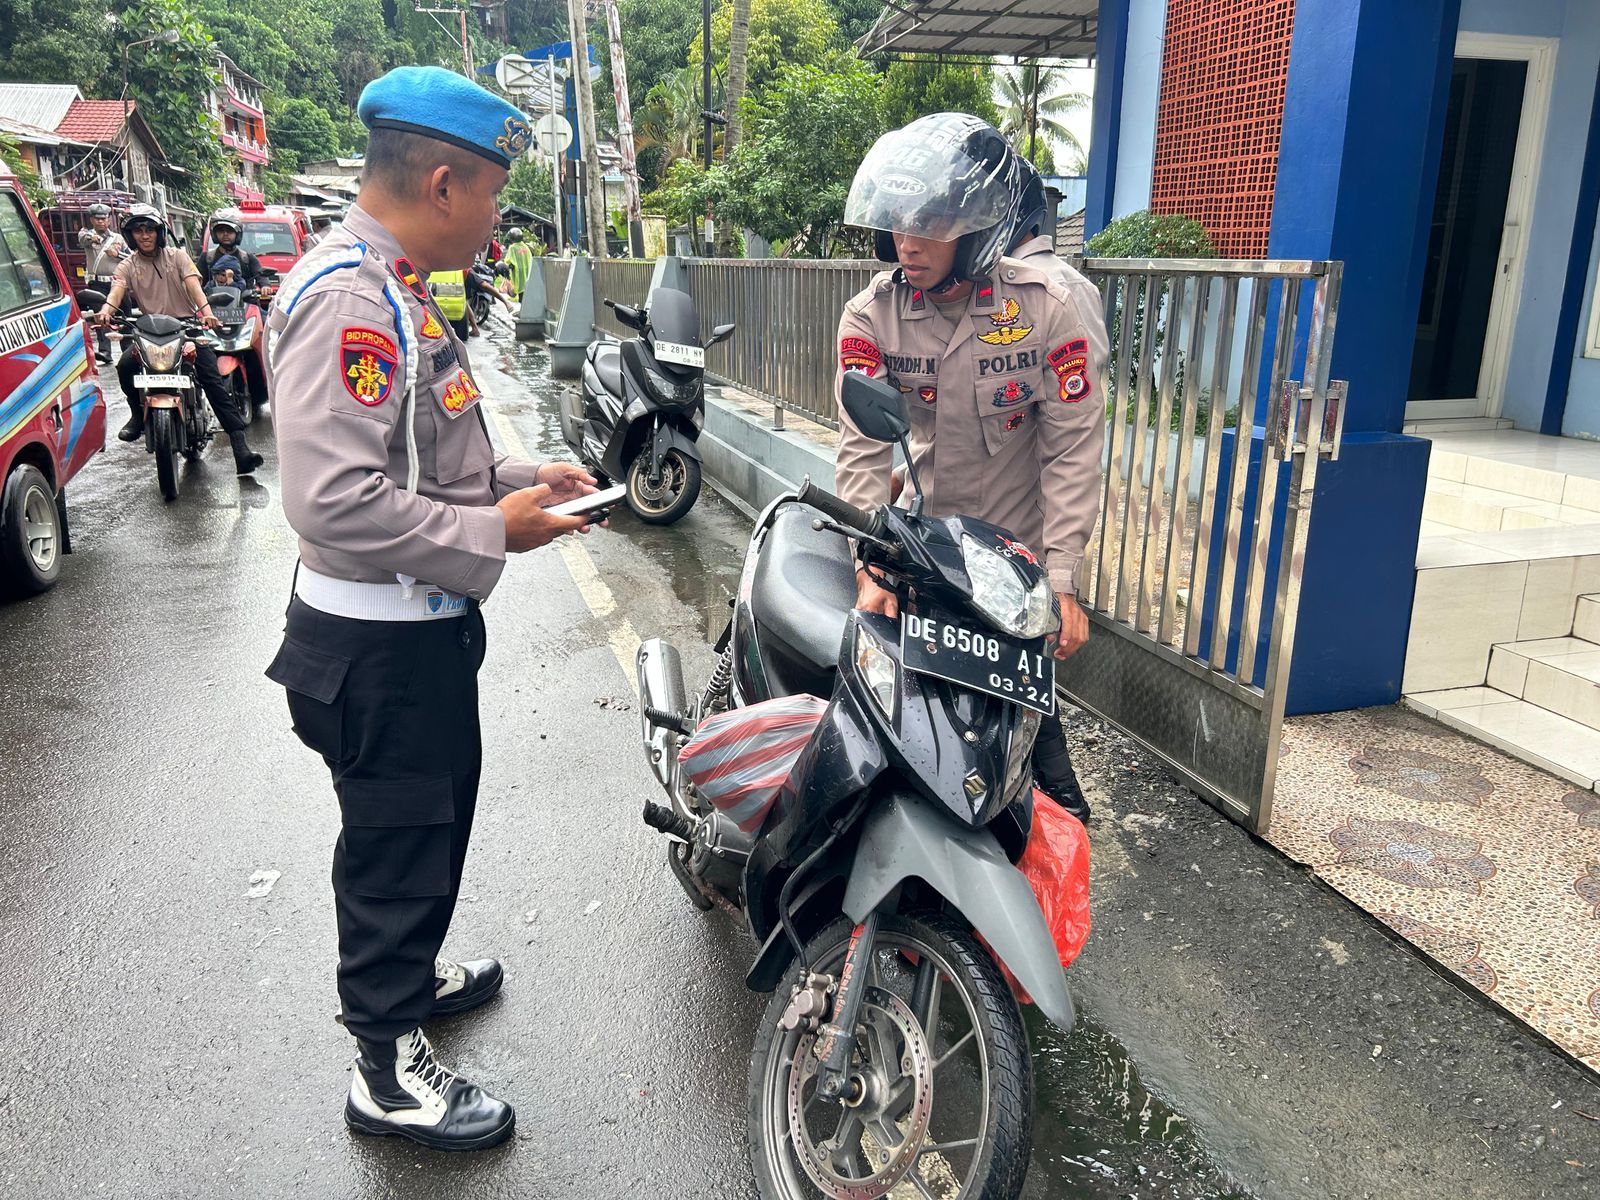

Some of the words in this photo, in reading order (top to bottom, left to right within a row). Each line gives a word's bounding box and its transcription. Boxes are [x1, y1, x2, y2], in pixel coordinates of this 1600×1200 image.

[20, 312, 51, 343] KOTA
[656, 342, 666, 352] DE
[670, 345, 689, 355] 2811
[978, 349, 1038, 376] POLRI
[1057, 357, 1086, 374] MALUKU
[907, 614, 937, 643] DE
[942, 624, 1000, 662] 6508
